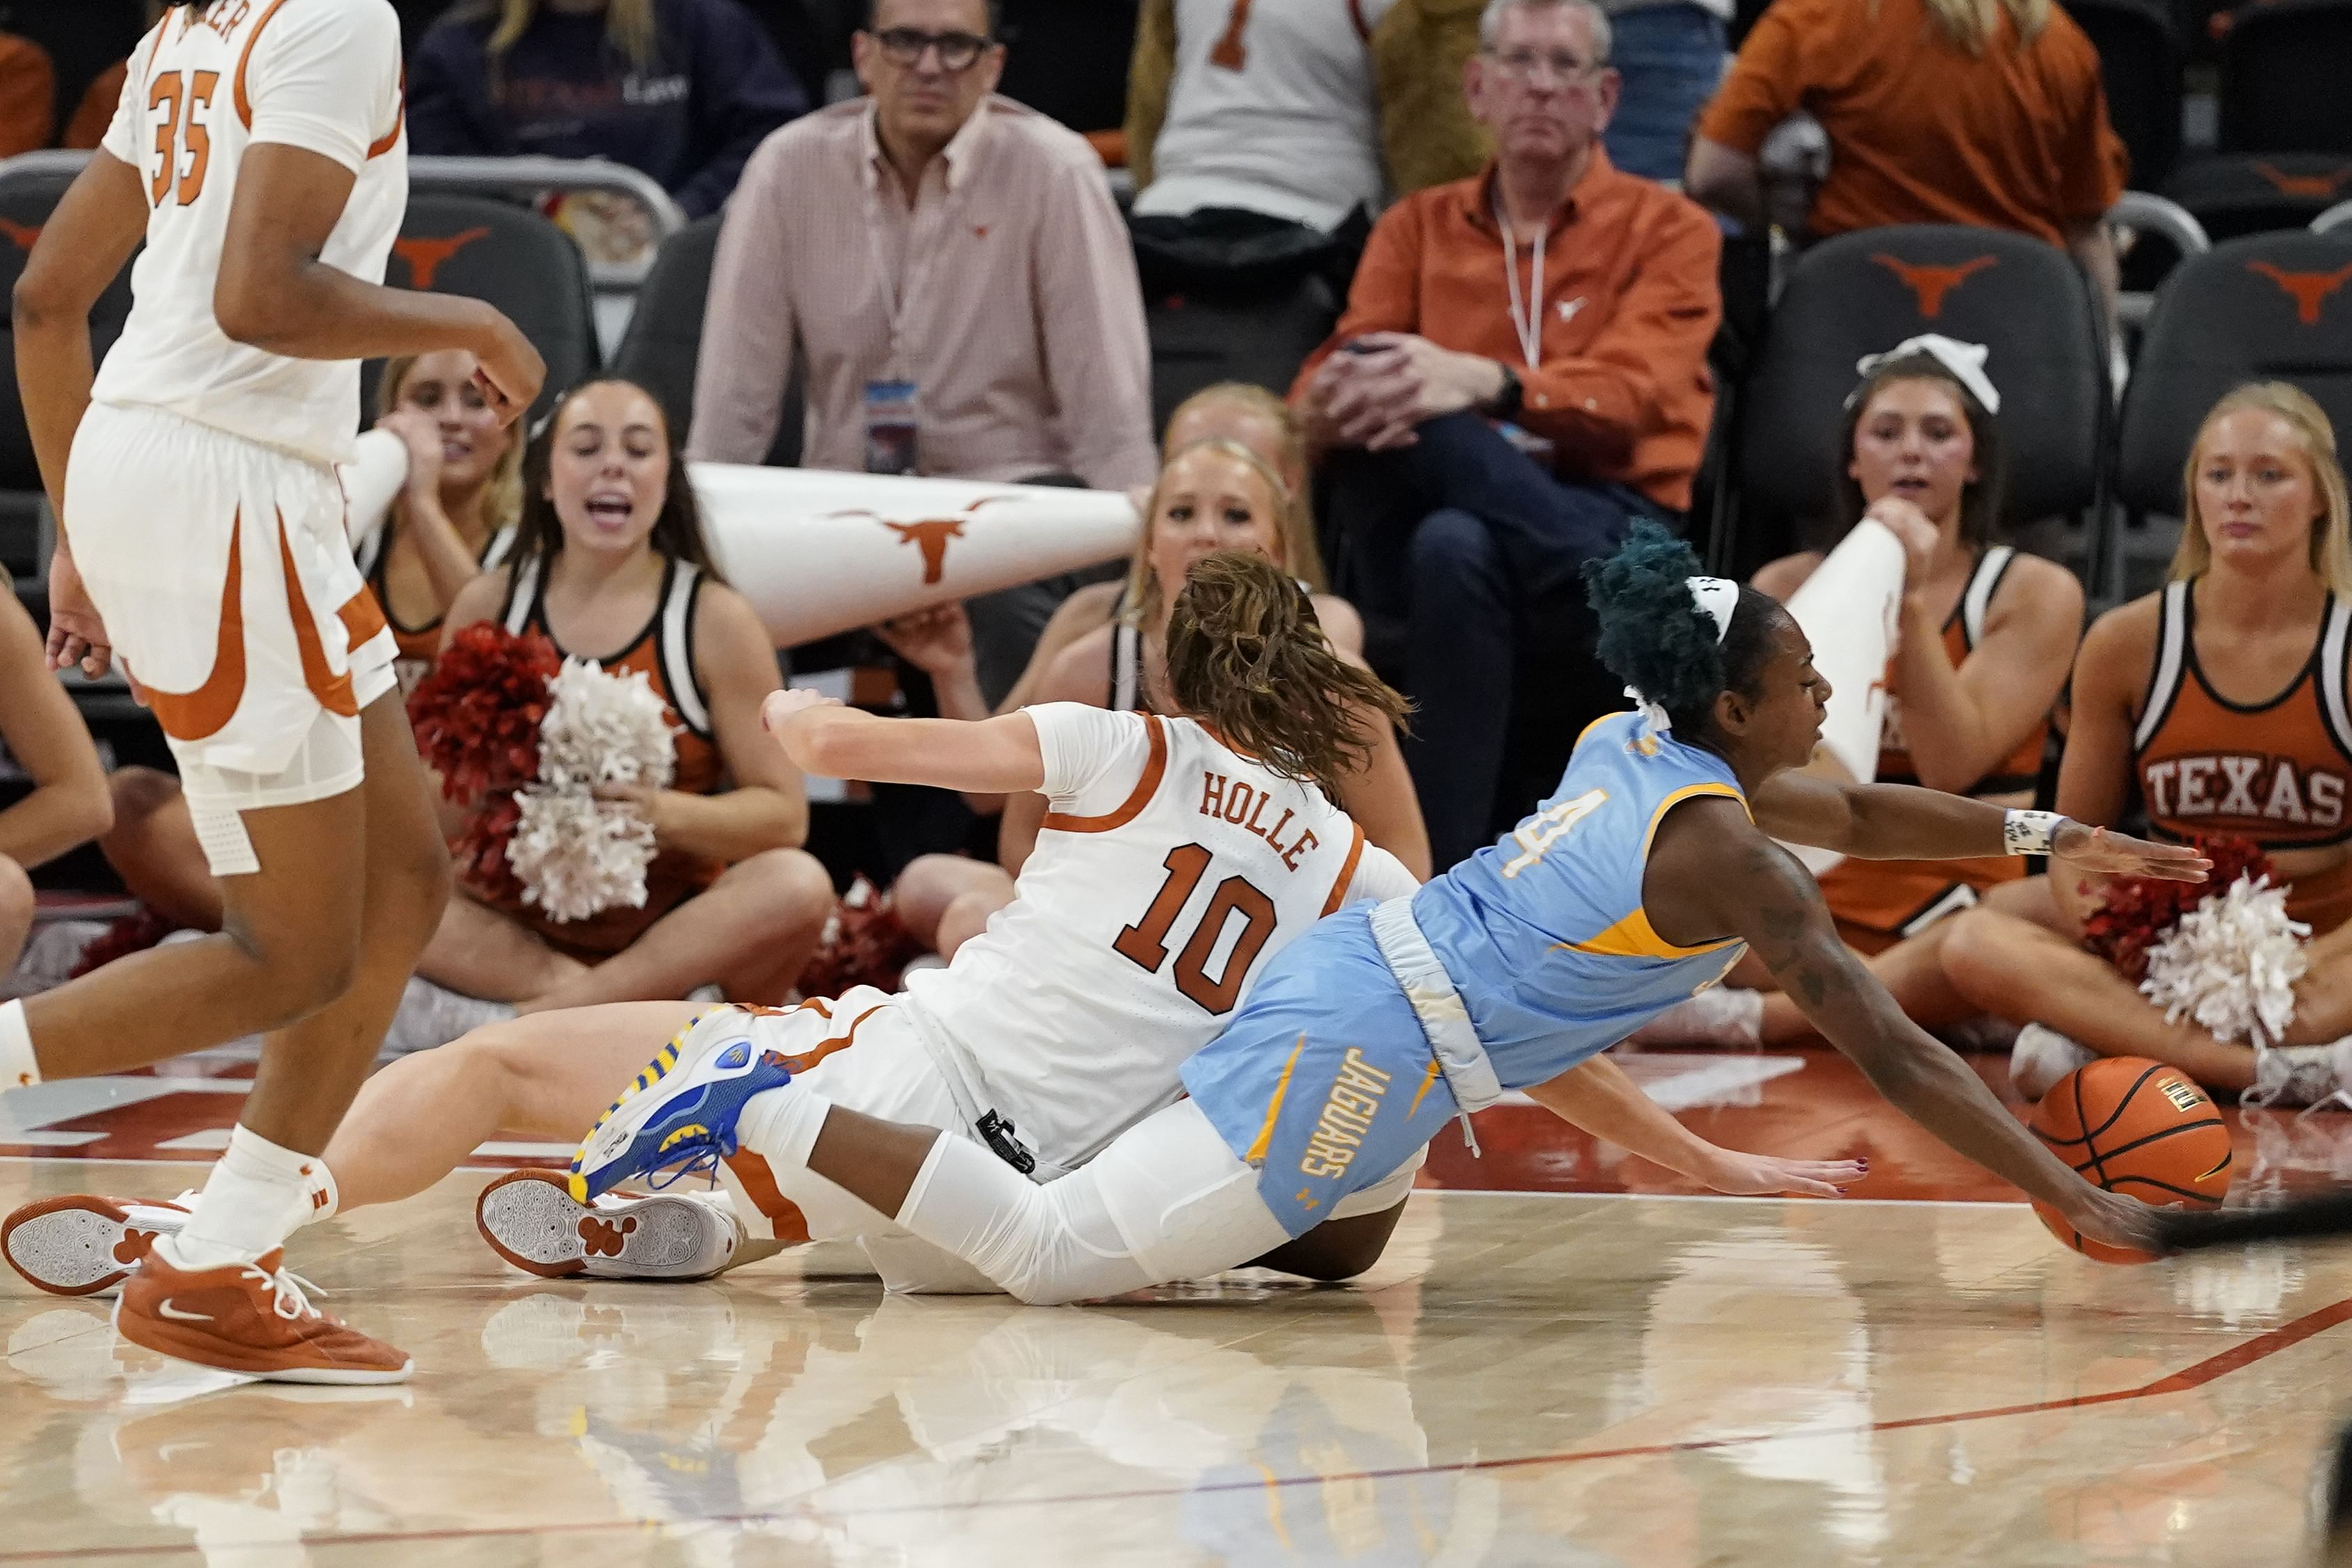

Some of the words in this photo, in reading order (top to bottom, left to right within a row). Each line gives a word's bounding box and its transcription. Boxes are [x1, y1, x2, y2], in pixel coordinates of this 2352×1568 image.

[148, 70, 220, 208] 35
[1200, 771, 1319, 872] HOLLE
[1500, 787, 1610, 879] 4
[2145, 755, 2346, 826] TEXAS
[1112, 842, 1277, 1017] 10
[1300, 1046, 1392, 1180] JAGUARS
